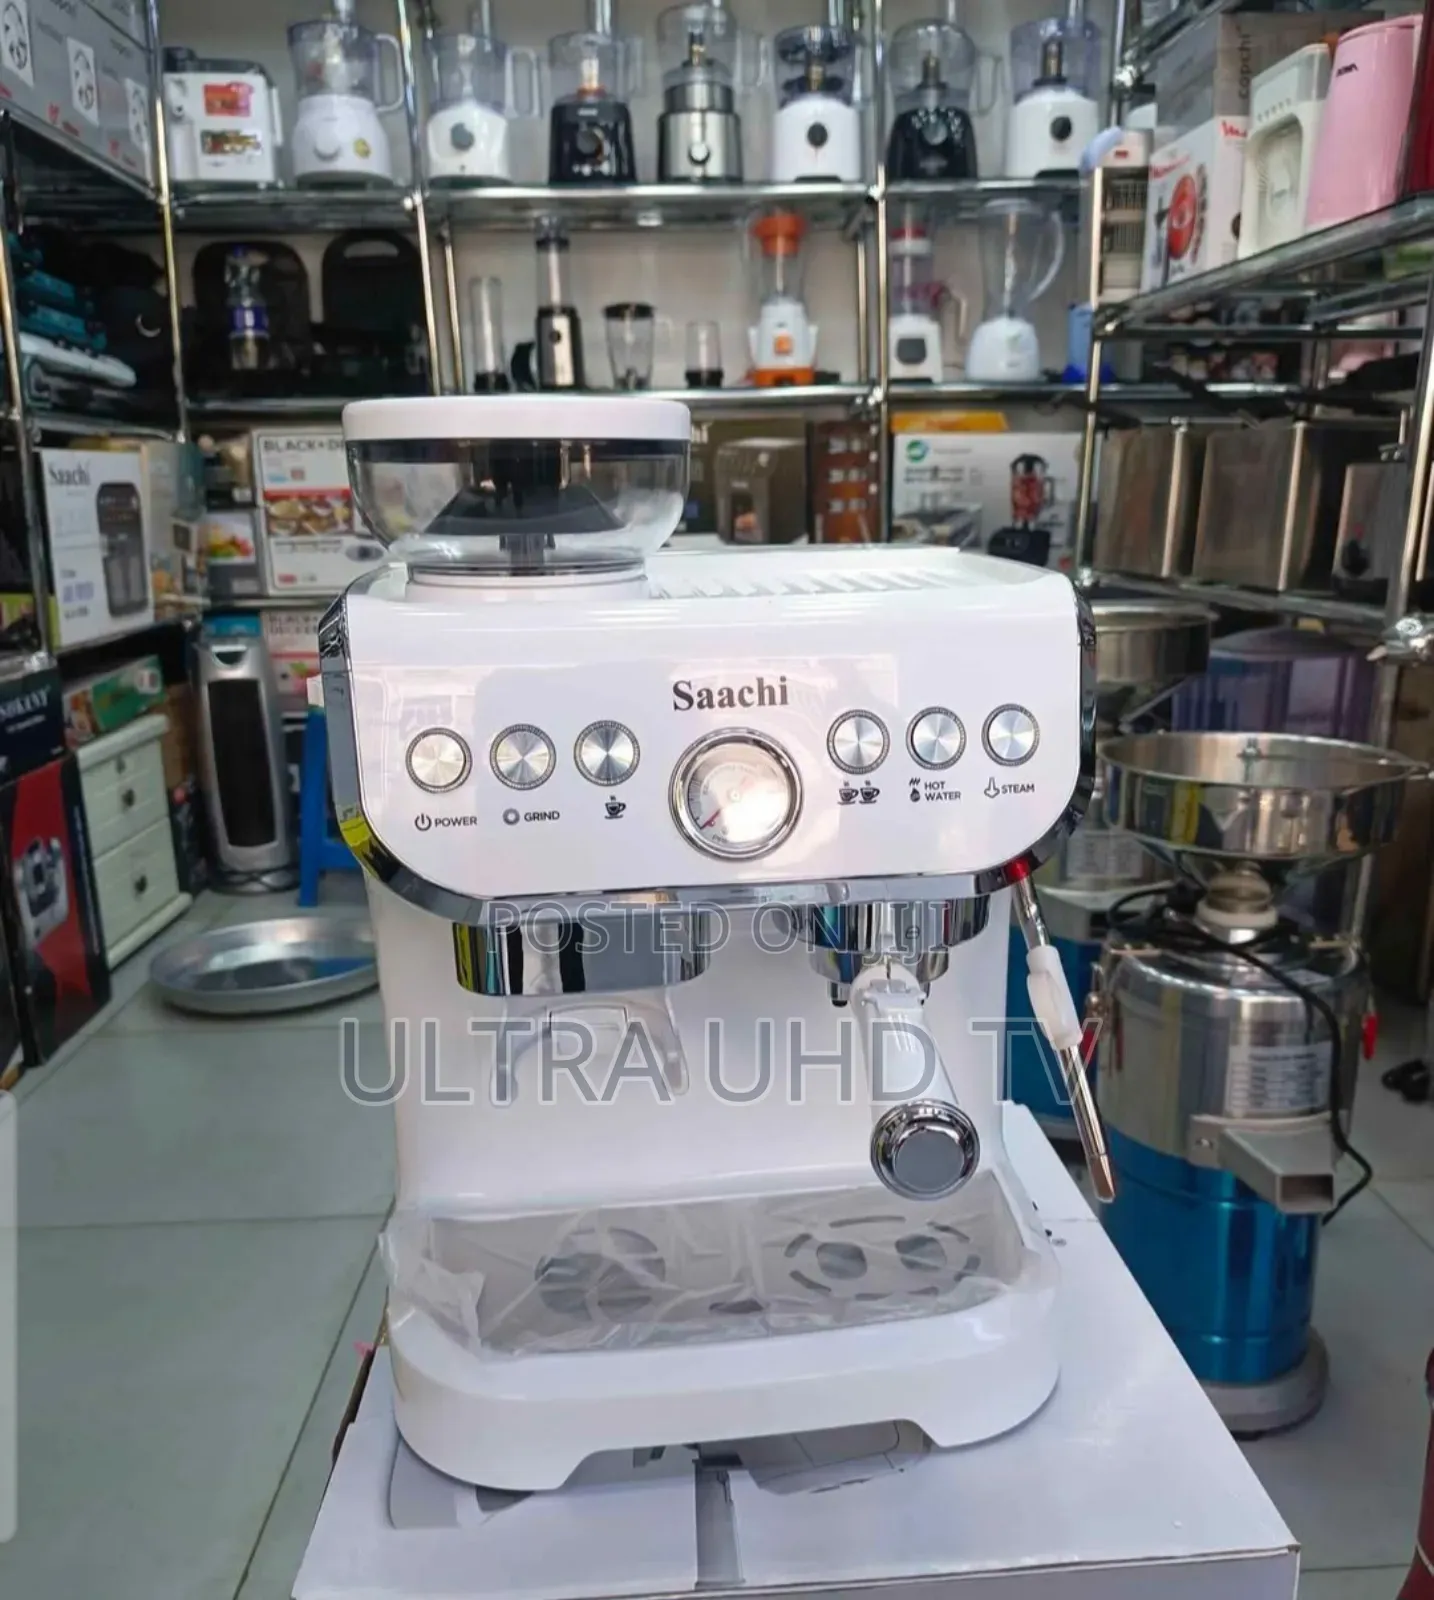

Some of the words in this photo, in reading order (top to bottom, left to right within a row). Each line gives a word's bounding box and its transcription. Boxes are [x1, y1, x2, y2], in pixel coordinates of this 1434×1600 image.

[672, 675, 789, 711] Saachi
[924, 781, 946, 790] HOT
[1001, 783, 1035, 794] STEAM
[924, 791, 961, 801] WATER
[523, 810, 560, 822] GRIND
[434, 816, 477, 828] POWER
